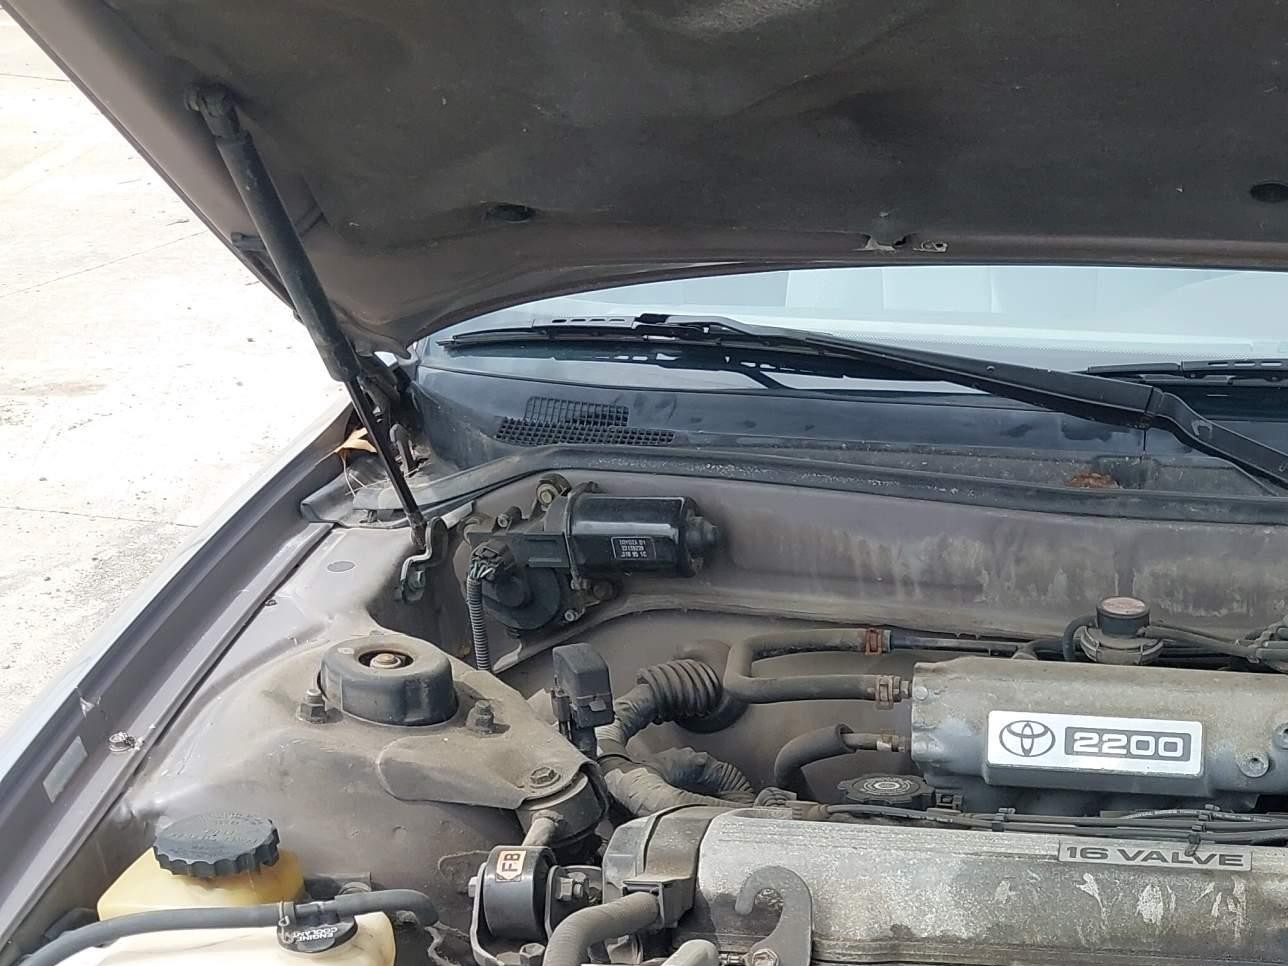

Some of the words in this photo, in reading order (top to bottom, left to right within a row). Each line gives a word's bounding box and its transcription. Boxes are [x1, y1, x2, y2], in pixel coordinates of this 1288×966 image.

[1072, 731, 1185, 757] 2200
[501, 853, 521, 873] FB
[1066, 846, 1112, 862] 16
[1116, 848, 1244, 867] VALVE
